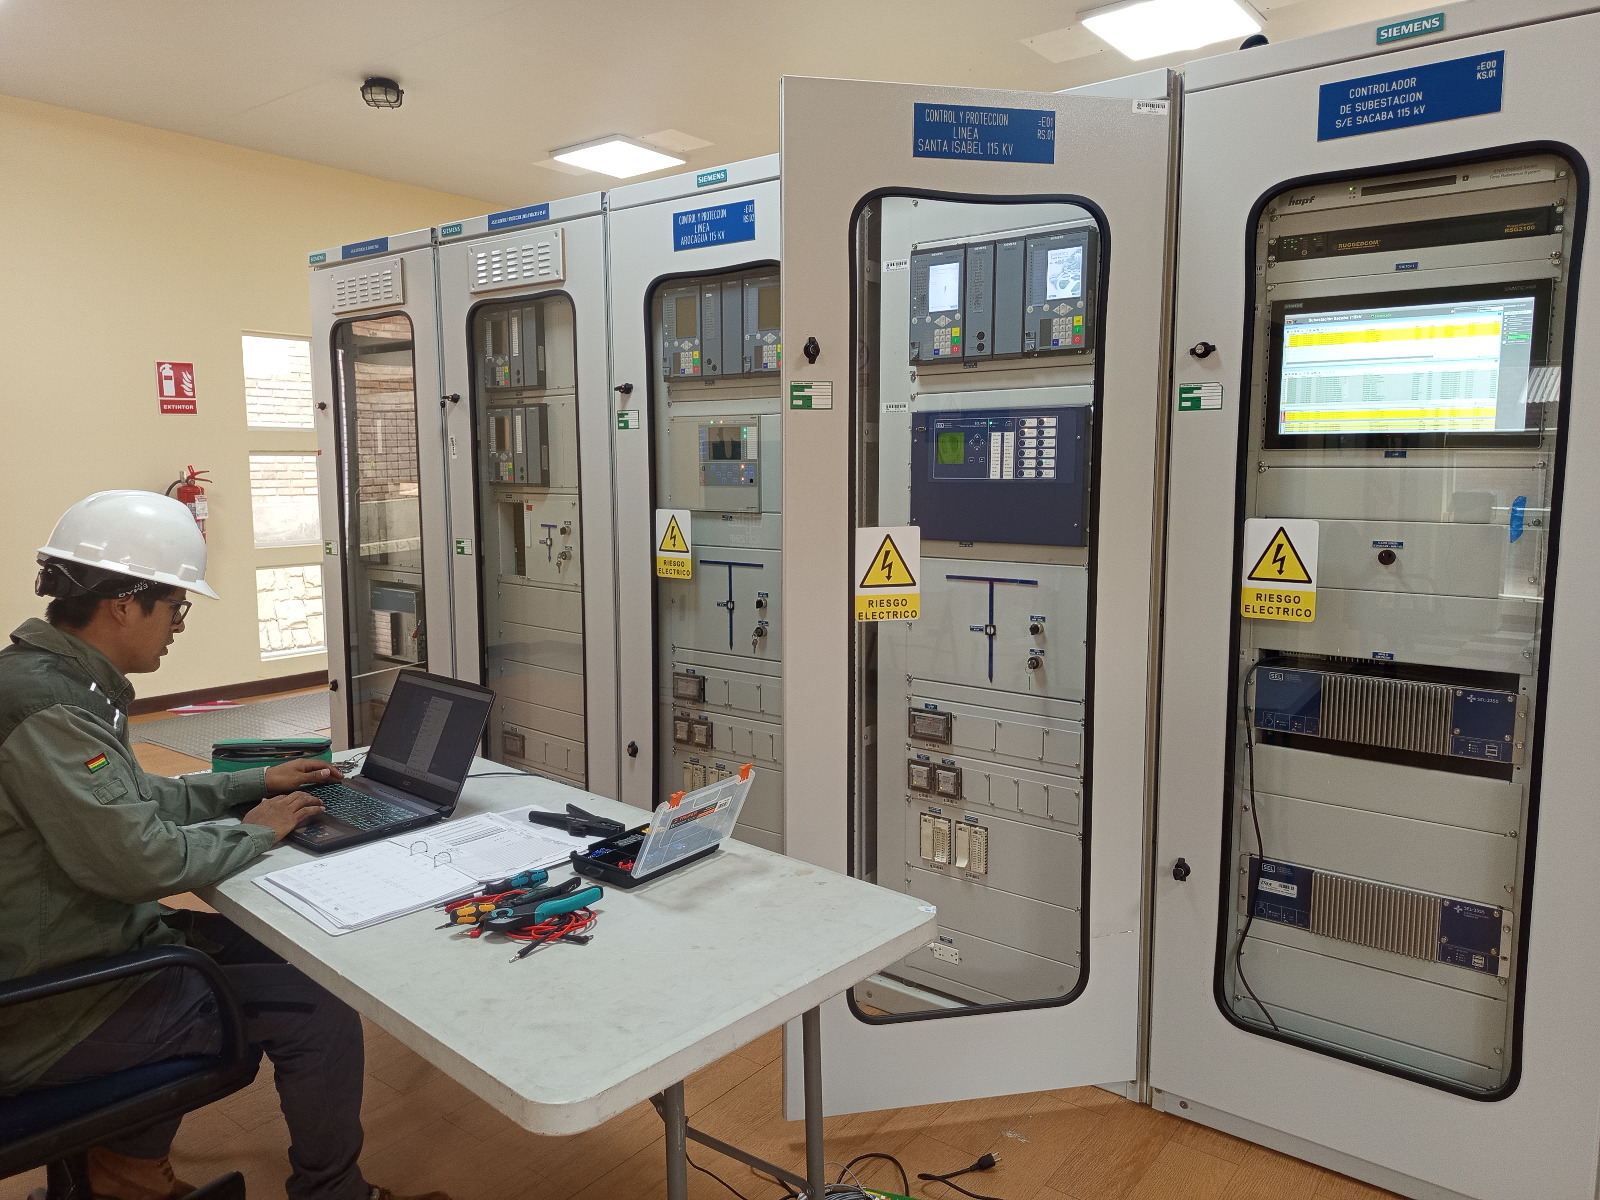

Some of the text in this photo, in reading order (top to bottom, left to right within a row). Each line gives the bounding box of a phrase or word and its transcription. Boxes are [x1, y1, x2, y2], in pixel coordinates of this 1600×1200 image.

[1380, 18, 1440, 40] SIEMENS
[1476, 60, 1497, 70] =E00
[1476, 70, 1496, 80] KS.01
[1350, 77, 1417, 98] CONTROLADOR
[1340, 92, 1423, 115] DE SUBESTACION
[925, 109, 1009, 126] CONTROL Y PROTECCION
[1038, 117, 1053, 128] =E01
[1336, 116, 1353, 128] S/E
[1356, 108, 1394, 125] SACABA
[1397, 106, 1411, 118] 115
[953, 127, 978, 139] LINEA
[1037, 129, 1054, 140] RS.01
[918, 139, 1014, 155] SANTA ISABEL 115 KV
[698, 172, 725, 183] SIEMENS
[679, 213, 697, 225] CONTROL
[701, 209, 727, 221] PROTECCION
[695, 223, 709, 233] LINEA
[658, 568, 690, 576] ELECTRICO
[868, 598, 908, 608] RIESGO
[1256, 593, 1301, 604] RIESGO
[858, 610, 918, 620] ELECTRICO
[1244, 605, 1312, 617] ELECTRICO
